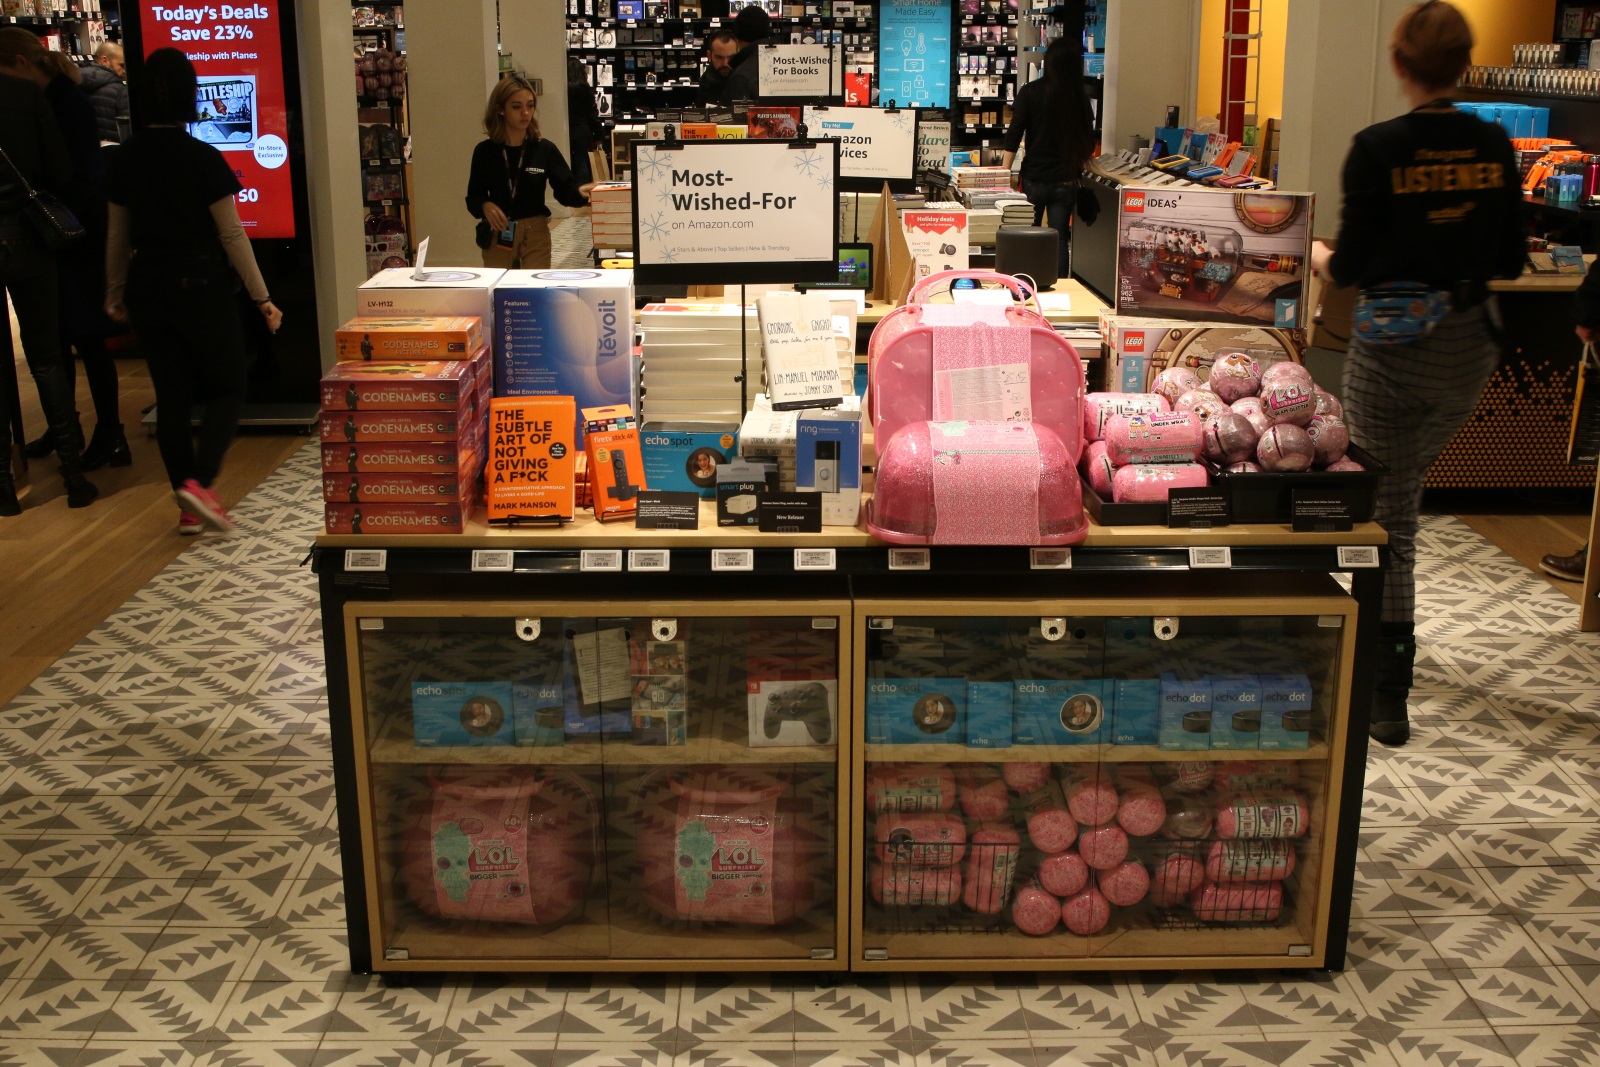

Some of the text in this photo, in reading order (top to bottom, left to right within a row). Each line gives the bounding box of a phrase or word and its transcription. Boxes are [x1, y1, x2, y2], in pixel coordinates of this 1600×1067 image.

[152, 4, 269, 24] Today's Deals
[895, 7, 936, 17] Made Easy
[170, 25, 254, 41] Save 23%
[186, 51, 258, 62] leship with Planes
[773, 66, 819, 75] For Books
[196, 82, 254, 101] TTLESHIP
[917, 133, 950, 146] dare
[839, 147, 869, 159] vices
[917, 146, 930, 156] to
[916, 156, 947, 168] lead
[672, 169, 734, 187] Most-
[671, 192, 797, 211] Wished-For
[1126, 198, 1178, 209] LEGO IDEAS
[671, 219, 754, 230] on Amazon.com
[767, 245, 790, 253] Trending
[382, 340, 439, 350] CODENAMES
[1125, 337, 1143, 346] LEGO
[773, 369, 840, 386] LIN-MANUEL MIRANDA
[362, 392, 436, 403] CODENAMES
[495, 409, 525, 422] THE
[361, 423, 435, 435] CODENAMES
[495, 420, 553, 434] SUBTLE
[800, 425, 818, 436] ring
[494, 433, 552, 447] ART OF
[645, 435, 694, 448] echo spot
[494, 446, 527, 459] NOT
[362, 454, 436, 466] CODENAMES
[494, 457, 549, 471] GIVING
[494, 472, 505, 484] A
[363, 484, 437, 496] CODENAMES
[739, 482, 755, 492] plug
[493, 501, 557, 510] MARK MANSON
[366, 515, 439, 526] CODENAMES
[416, 685, 443, 696] echo
[539, 688, 557, 698] dot
[870, 682, 897, 693] echo
[1019, 683, 1046, 694] echo
[1165, 692, 1207, 703] echo dot
[1215, 691, 1257, 702] echo dot
[1265, 691, 1306, 702] echo dot
[971, 737, 988, 745] echo
[1117, 734, 1135, 742] echo
[504, 817, 521, 826] 60+
